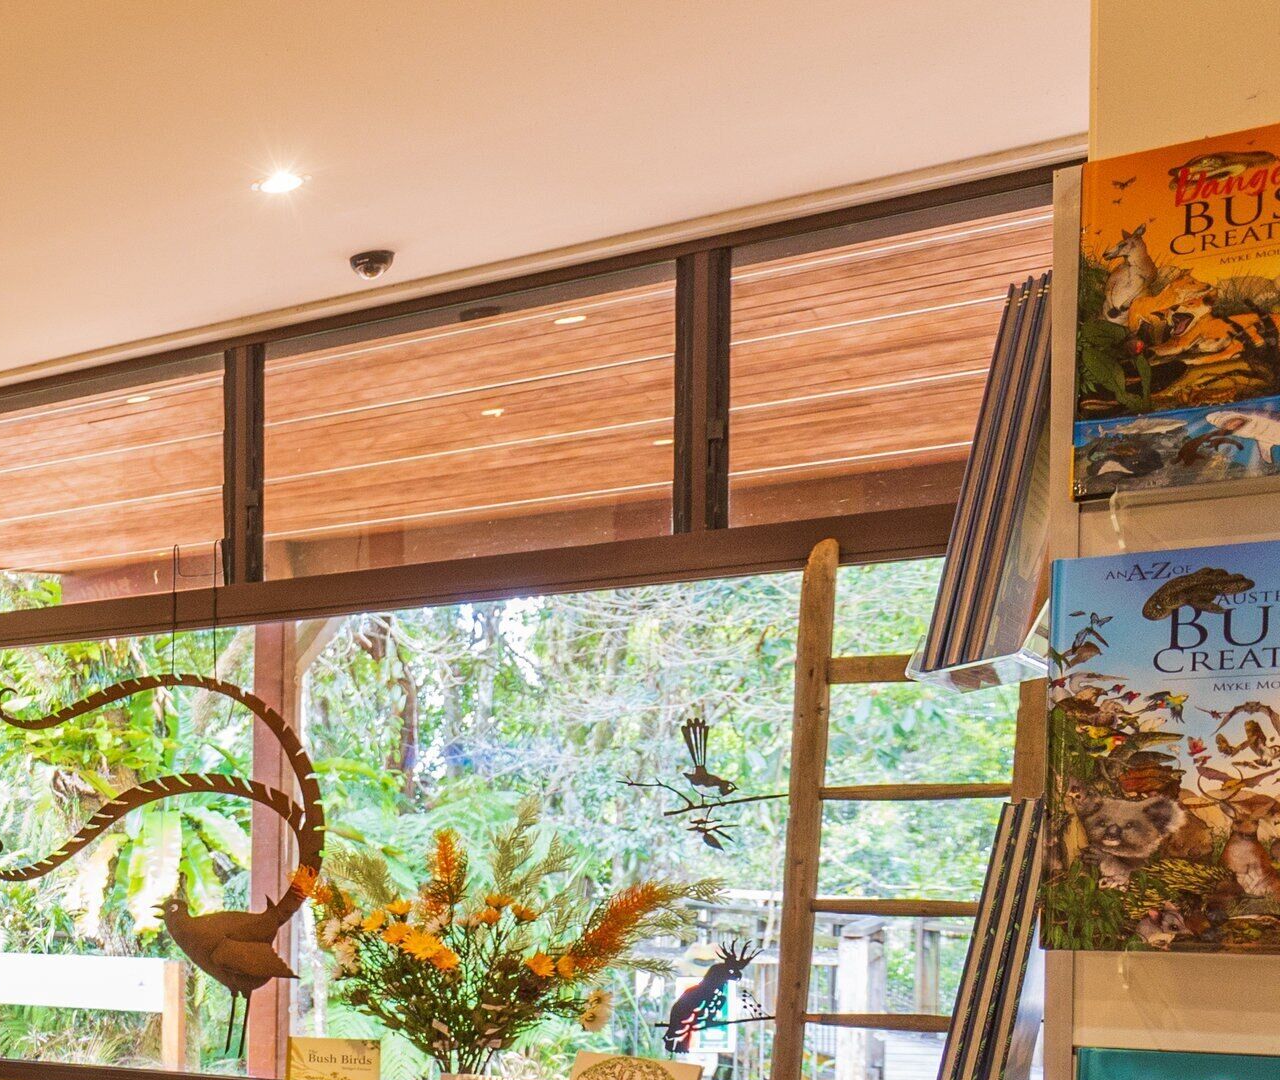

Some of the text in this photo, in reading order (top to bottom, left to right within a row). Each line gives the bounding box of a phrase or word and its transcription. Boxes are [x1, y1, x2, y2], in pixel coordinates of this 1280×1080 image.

[1219, 251, 1250, 265] MYKE
[1105, 569, 1127, 580] AN
[1126, 561, 1171, 582] A-Z
[1213, 681, 1251, 692] MYKE
[308, 1054, 373, 1065] Bush Birds
